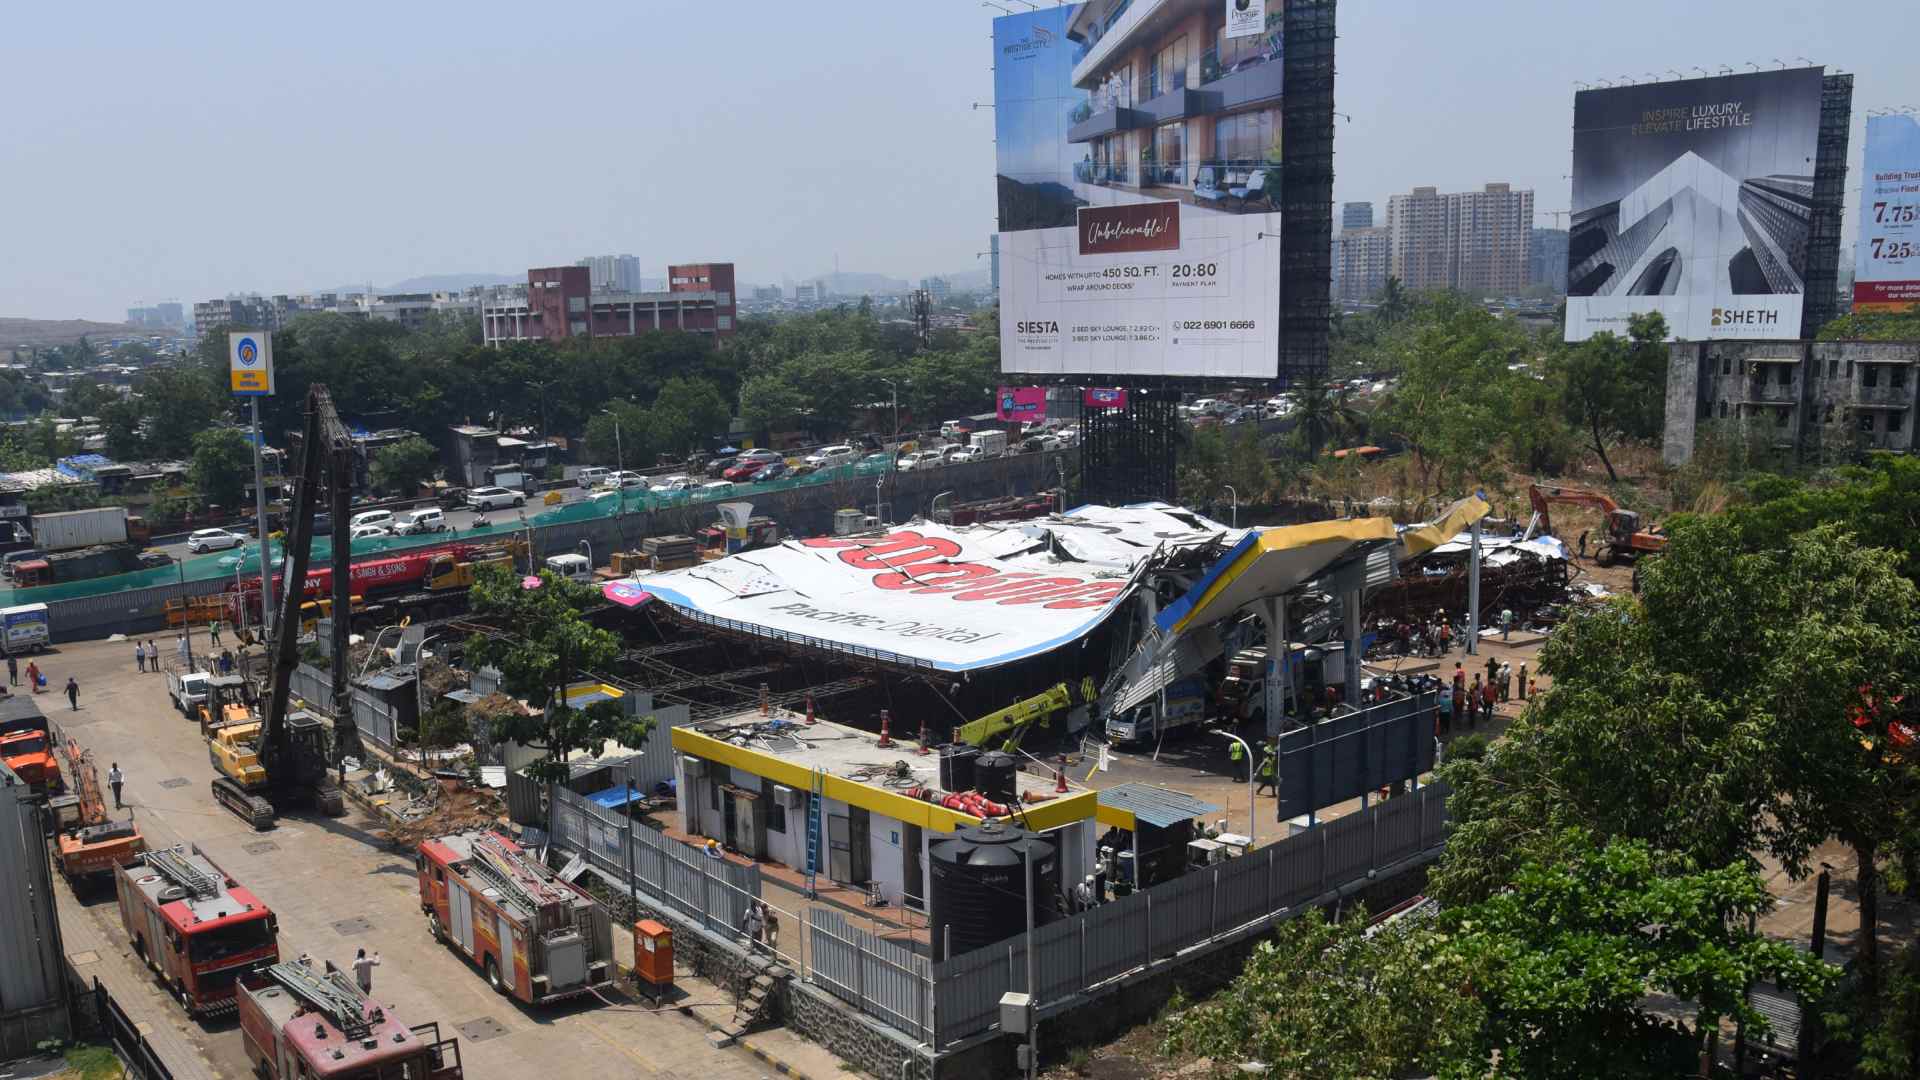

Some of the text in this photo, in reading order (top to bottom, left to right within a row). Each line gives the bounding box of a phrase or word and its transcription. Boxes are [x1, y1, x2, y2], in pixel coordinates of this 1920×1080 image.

[1088, 216, 1170, 244] Unbelievable!
[1102, 267, 1121, 278] 450
[1723, 309, 1778, 324] SHETH
[1017, 321, 1059, 334] SIESTA
[1183, 320, 1256, 330] 022 6901 6666
[770, 602, 1002, 644] Pacific Digital
